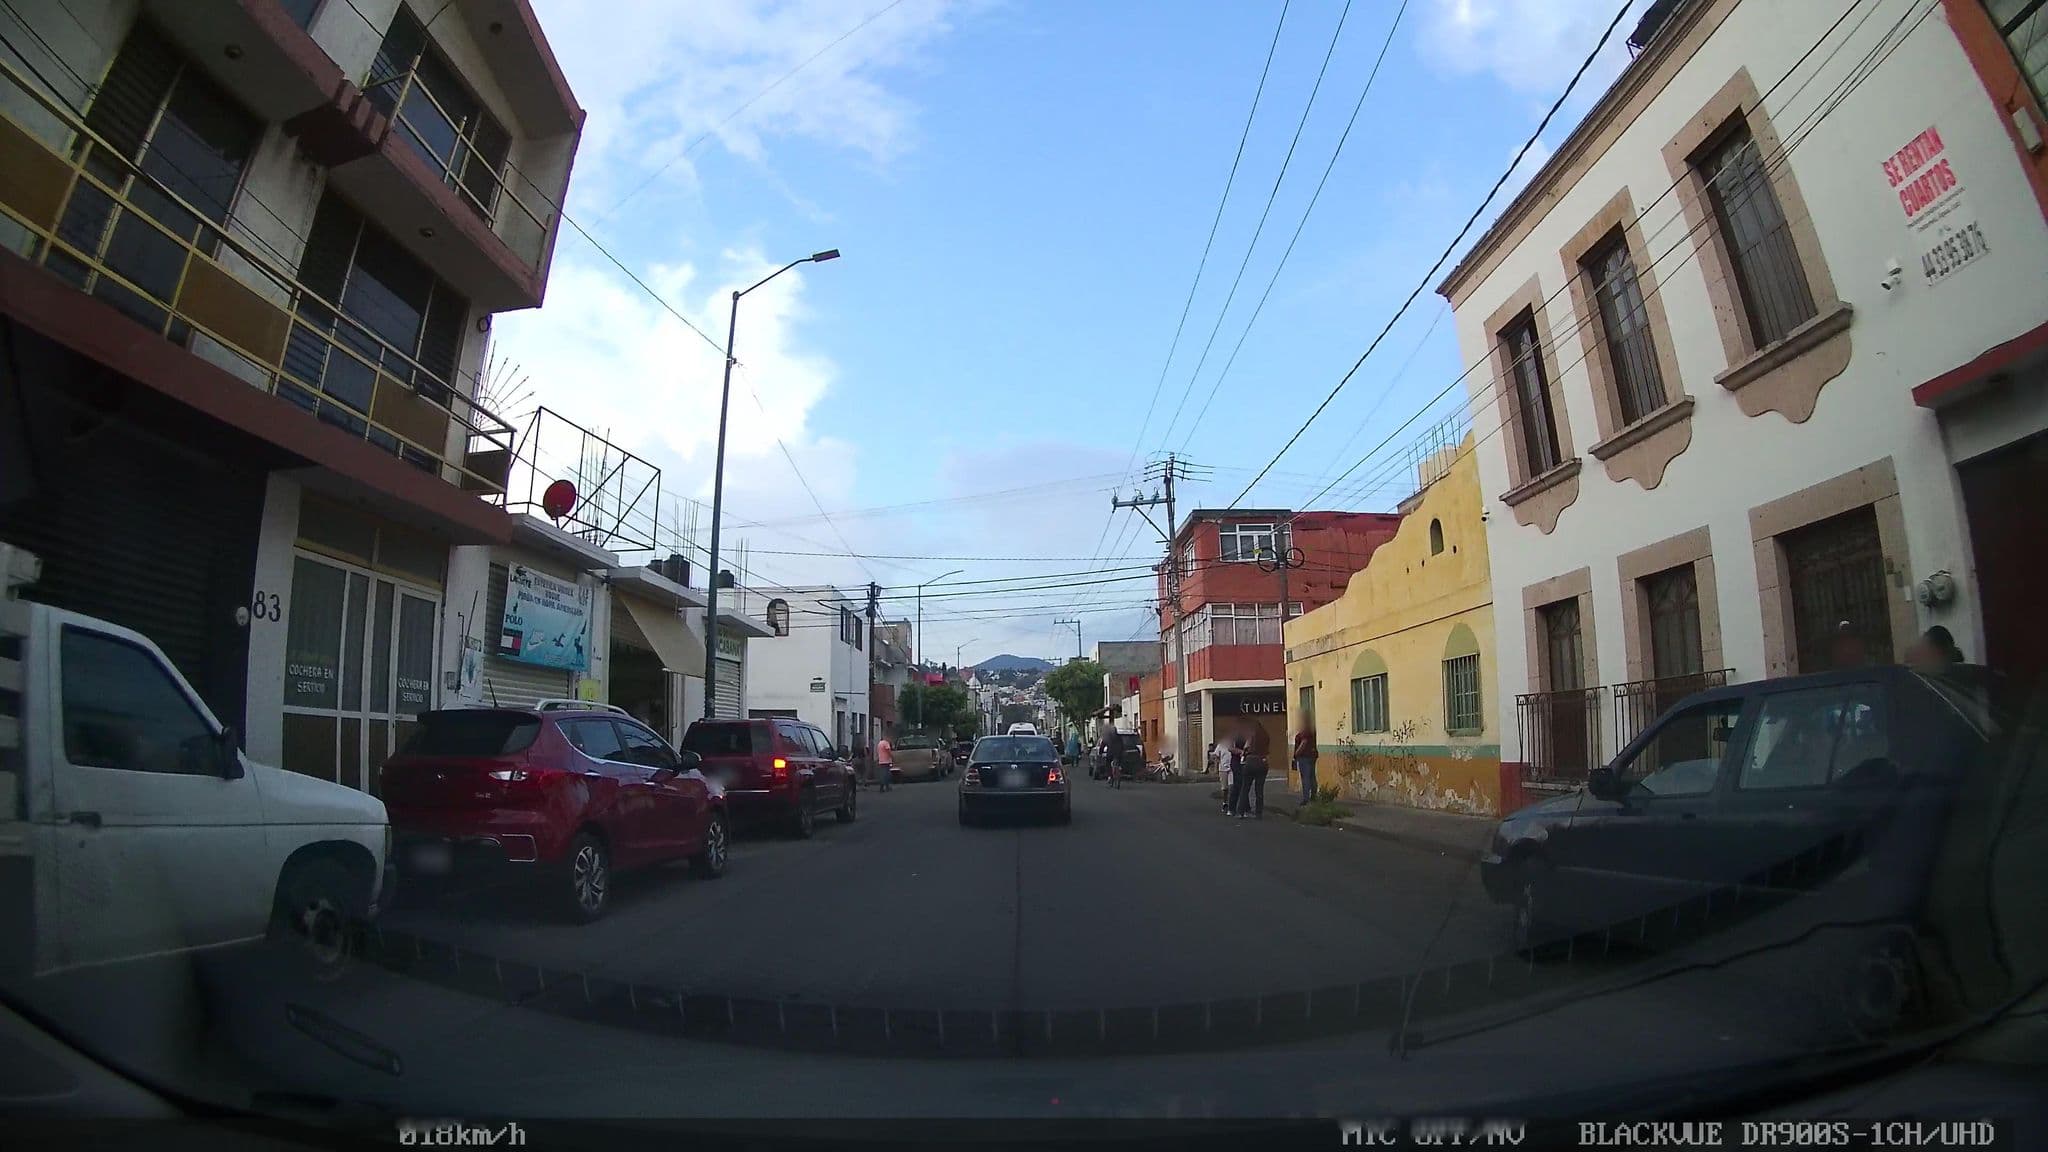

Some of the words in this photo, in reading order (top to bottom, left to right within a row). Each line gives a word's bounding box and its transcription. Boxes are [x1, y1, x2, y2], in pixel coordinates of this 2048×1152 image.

[1882, 158, 1904, 188] SE
[1899, 158, 1957, 217] CUARTOS
[253, 590, 281, 622] 83
[505, 613, 523, 626] POLO
[288, 663, 322, 678] COCHERA
[323, 668, 334, 679] EN
[1243, 702, 1287, 713] TUNEL
